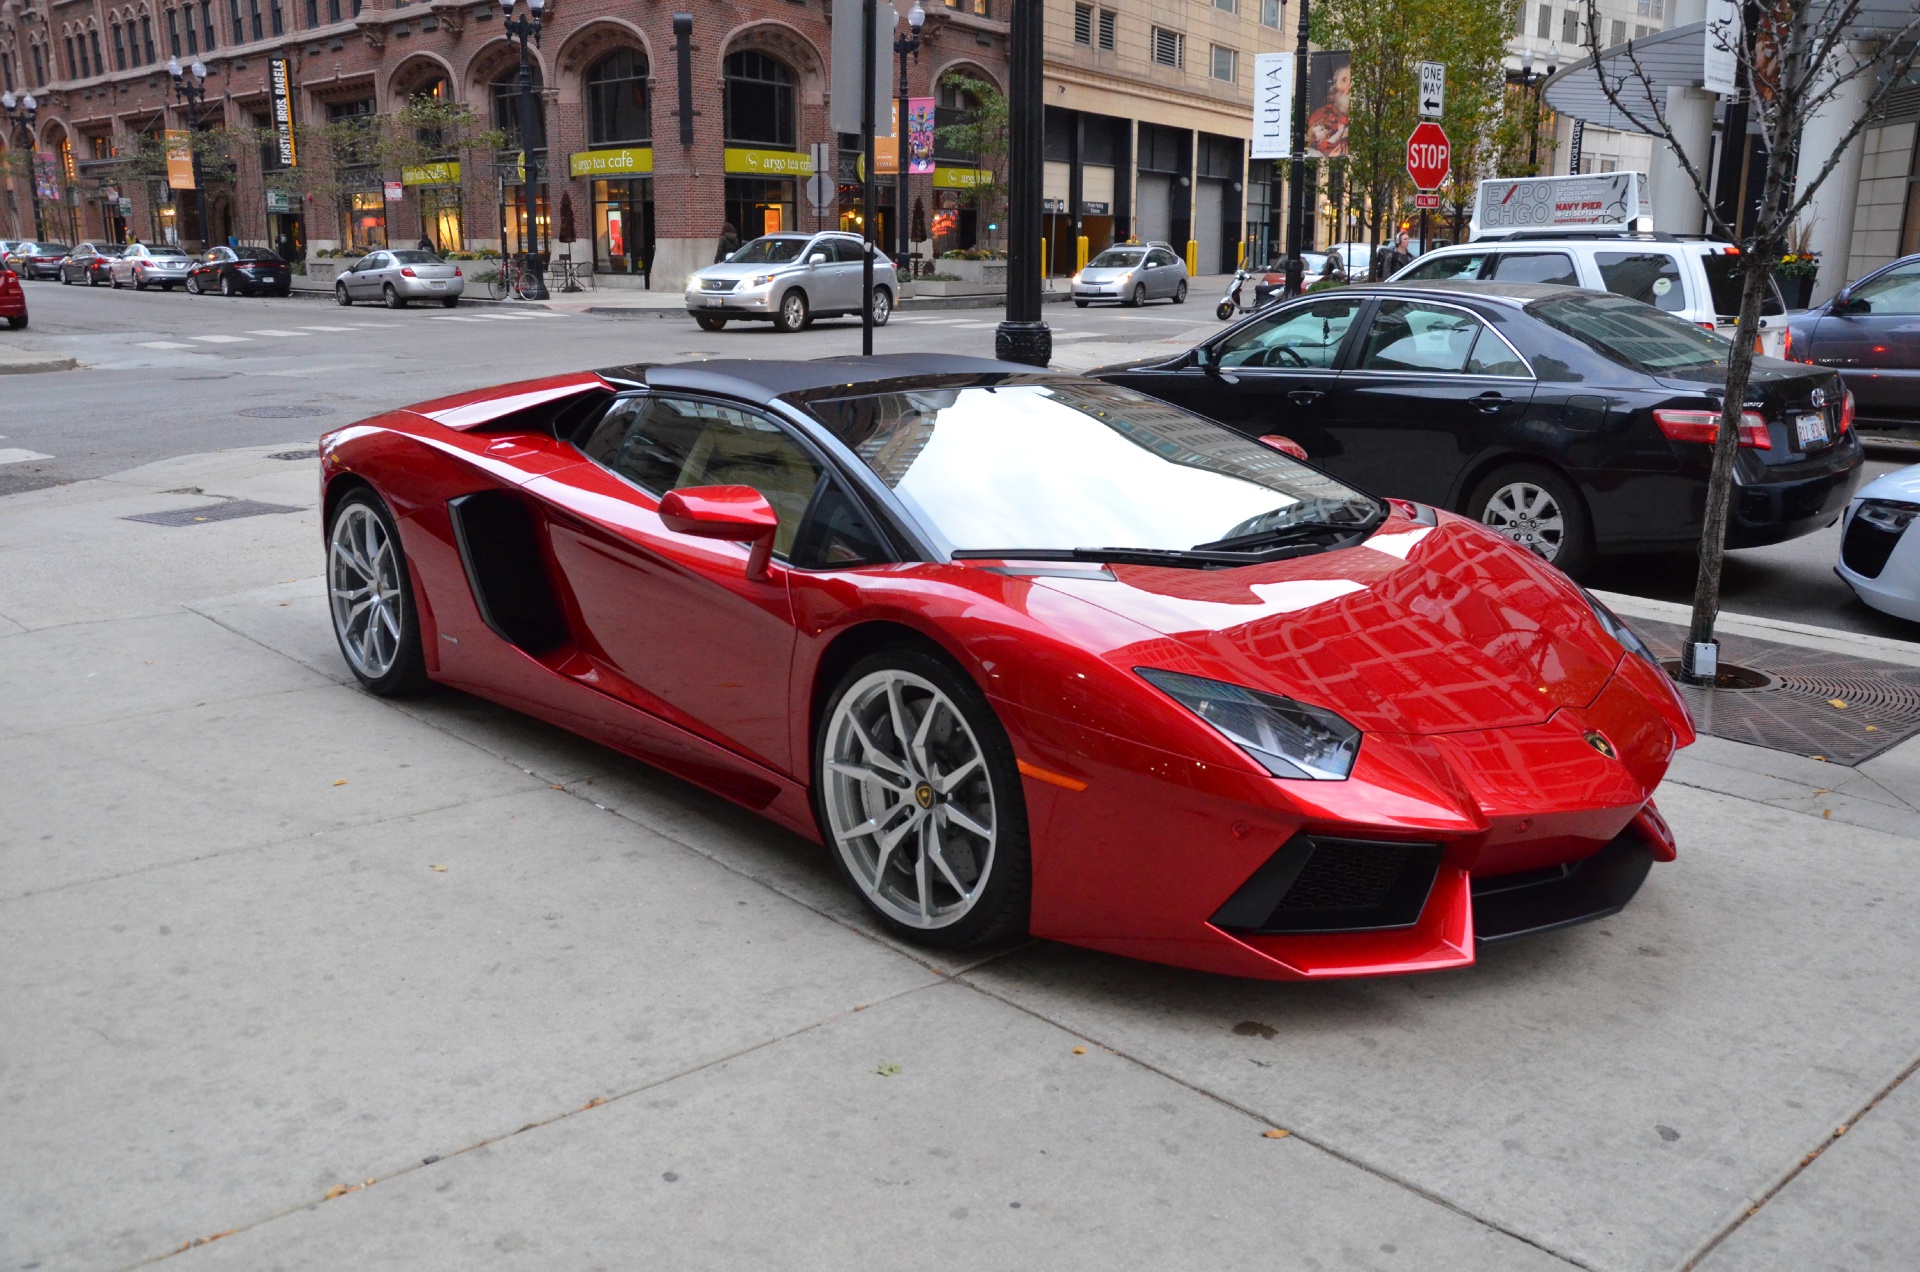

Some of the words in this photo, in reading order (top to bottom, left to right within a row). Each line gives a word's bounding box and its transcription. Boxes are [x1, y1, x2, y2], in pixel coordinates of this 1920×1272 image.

[272, 60, 286, 94] BAGELS
[1423, 66, 1442, 81] ONE
[1422, 81, 1442, 96] WAY
[276, 97, 288, 121] BROS.
[1263, 66, 1283, 137] LUMA
[279, 123, 292, 164] EINSTEIN
[1570, 119, 1582, 168] ORDSTROM
[577, 159, 591, 174] argo
[593, 157, 606, 169] tea
[608, 150, 634, 168] café
[763, 158, 786, 173] argo
[787, 157, 799, 170] tea
[1410, 143, 1448, 170] STOP
[961, 174, 976, 187] arg
[1569, 179, 1611, 187] INTERNATIONAL
[1418, 197, 1427, 206] ALL
[1428, 197, 1437, 206] WAY
[1487, 182, 1552, 206] EXPO
[1563, 189, 1607, 197] CONTEMPORARY
[1484, 203, 1550, 226] CHGO
[1555, 203, 1580, 211] NAVY
[1581, 201, 1602, 210] PIER
[1573, 209, 1611, 217] SEPTEMBER
